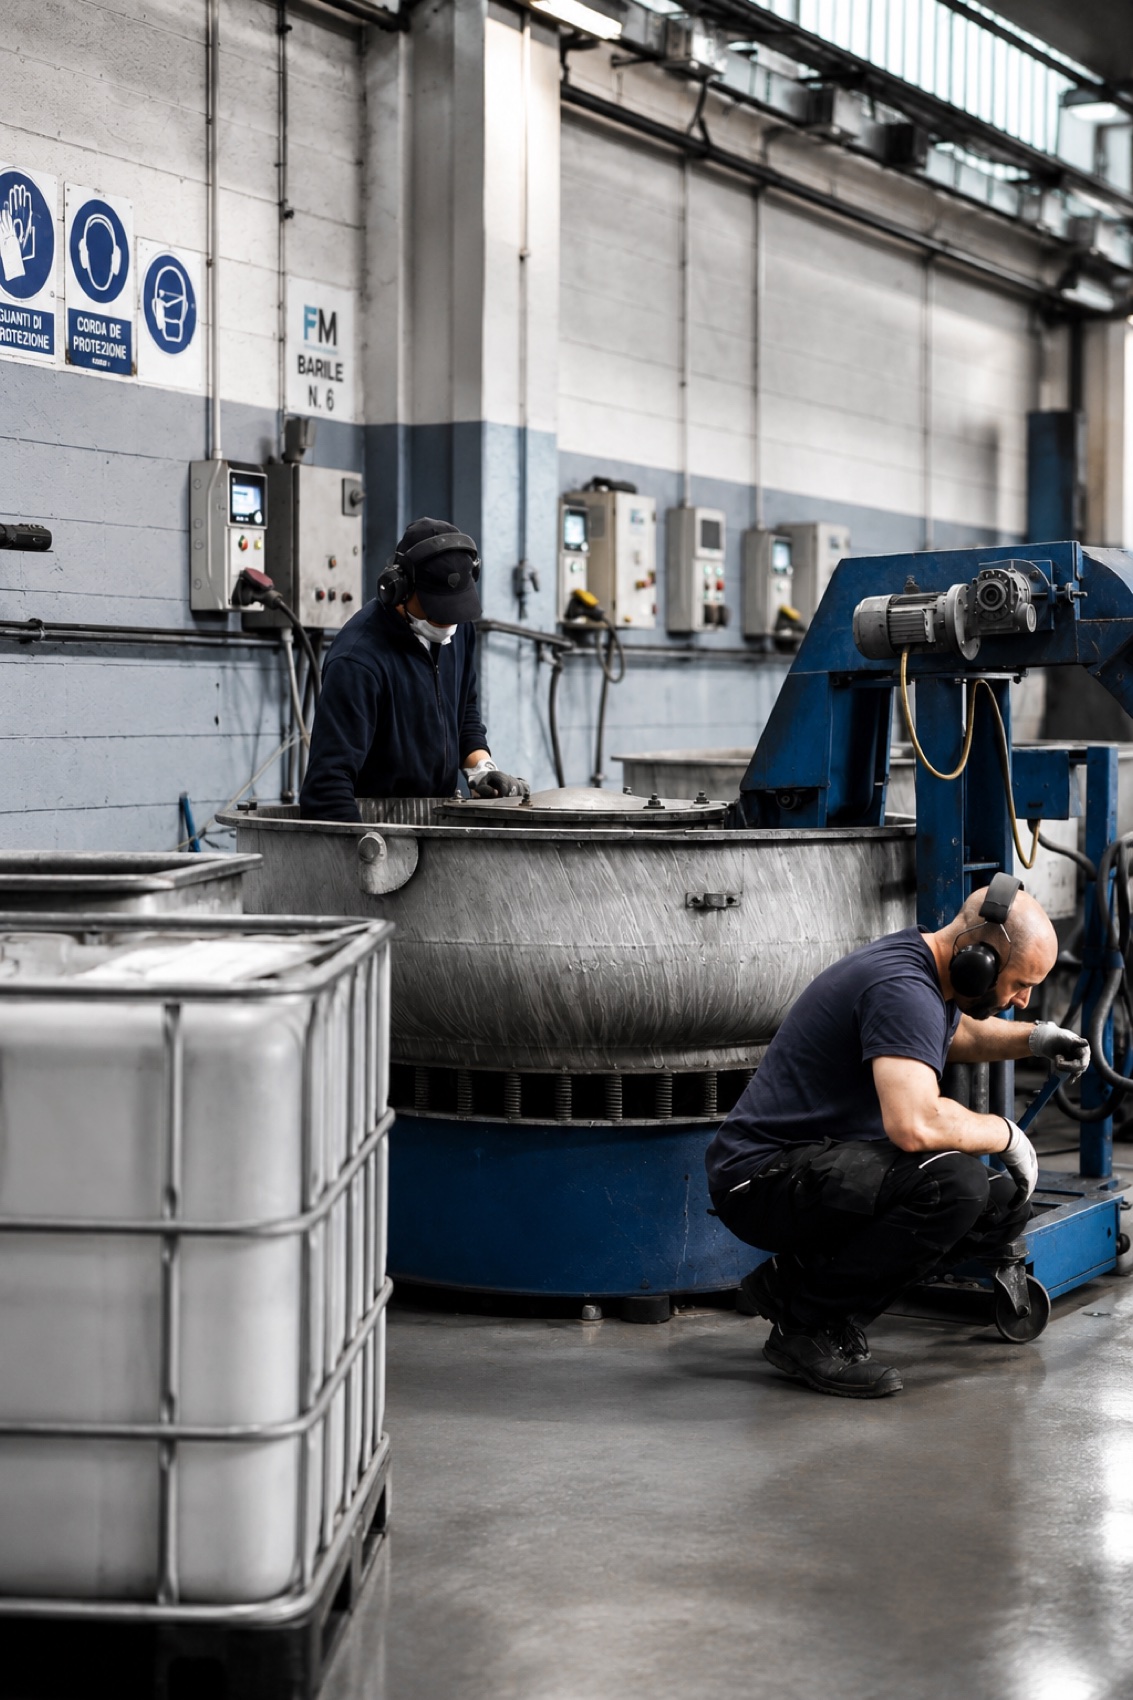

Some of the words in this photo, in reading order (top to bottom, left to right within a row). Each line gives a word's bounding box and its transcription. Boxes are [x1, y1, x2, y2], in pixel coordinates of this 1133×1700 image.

[0, 308, 30, 328] GUANTI
[33, 315, 42, 330] DI
[77, 316, 107, 336] CORDA
[109, 323, 122, 339] DE
[303, 304, 337, 346] FM
[0, 326, 50, 350] ROTEZIONE
[297, 354, 343, 382] BARILE
[308, 385, 322, 408] N.
[326, 388, 334, 411] 6
